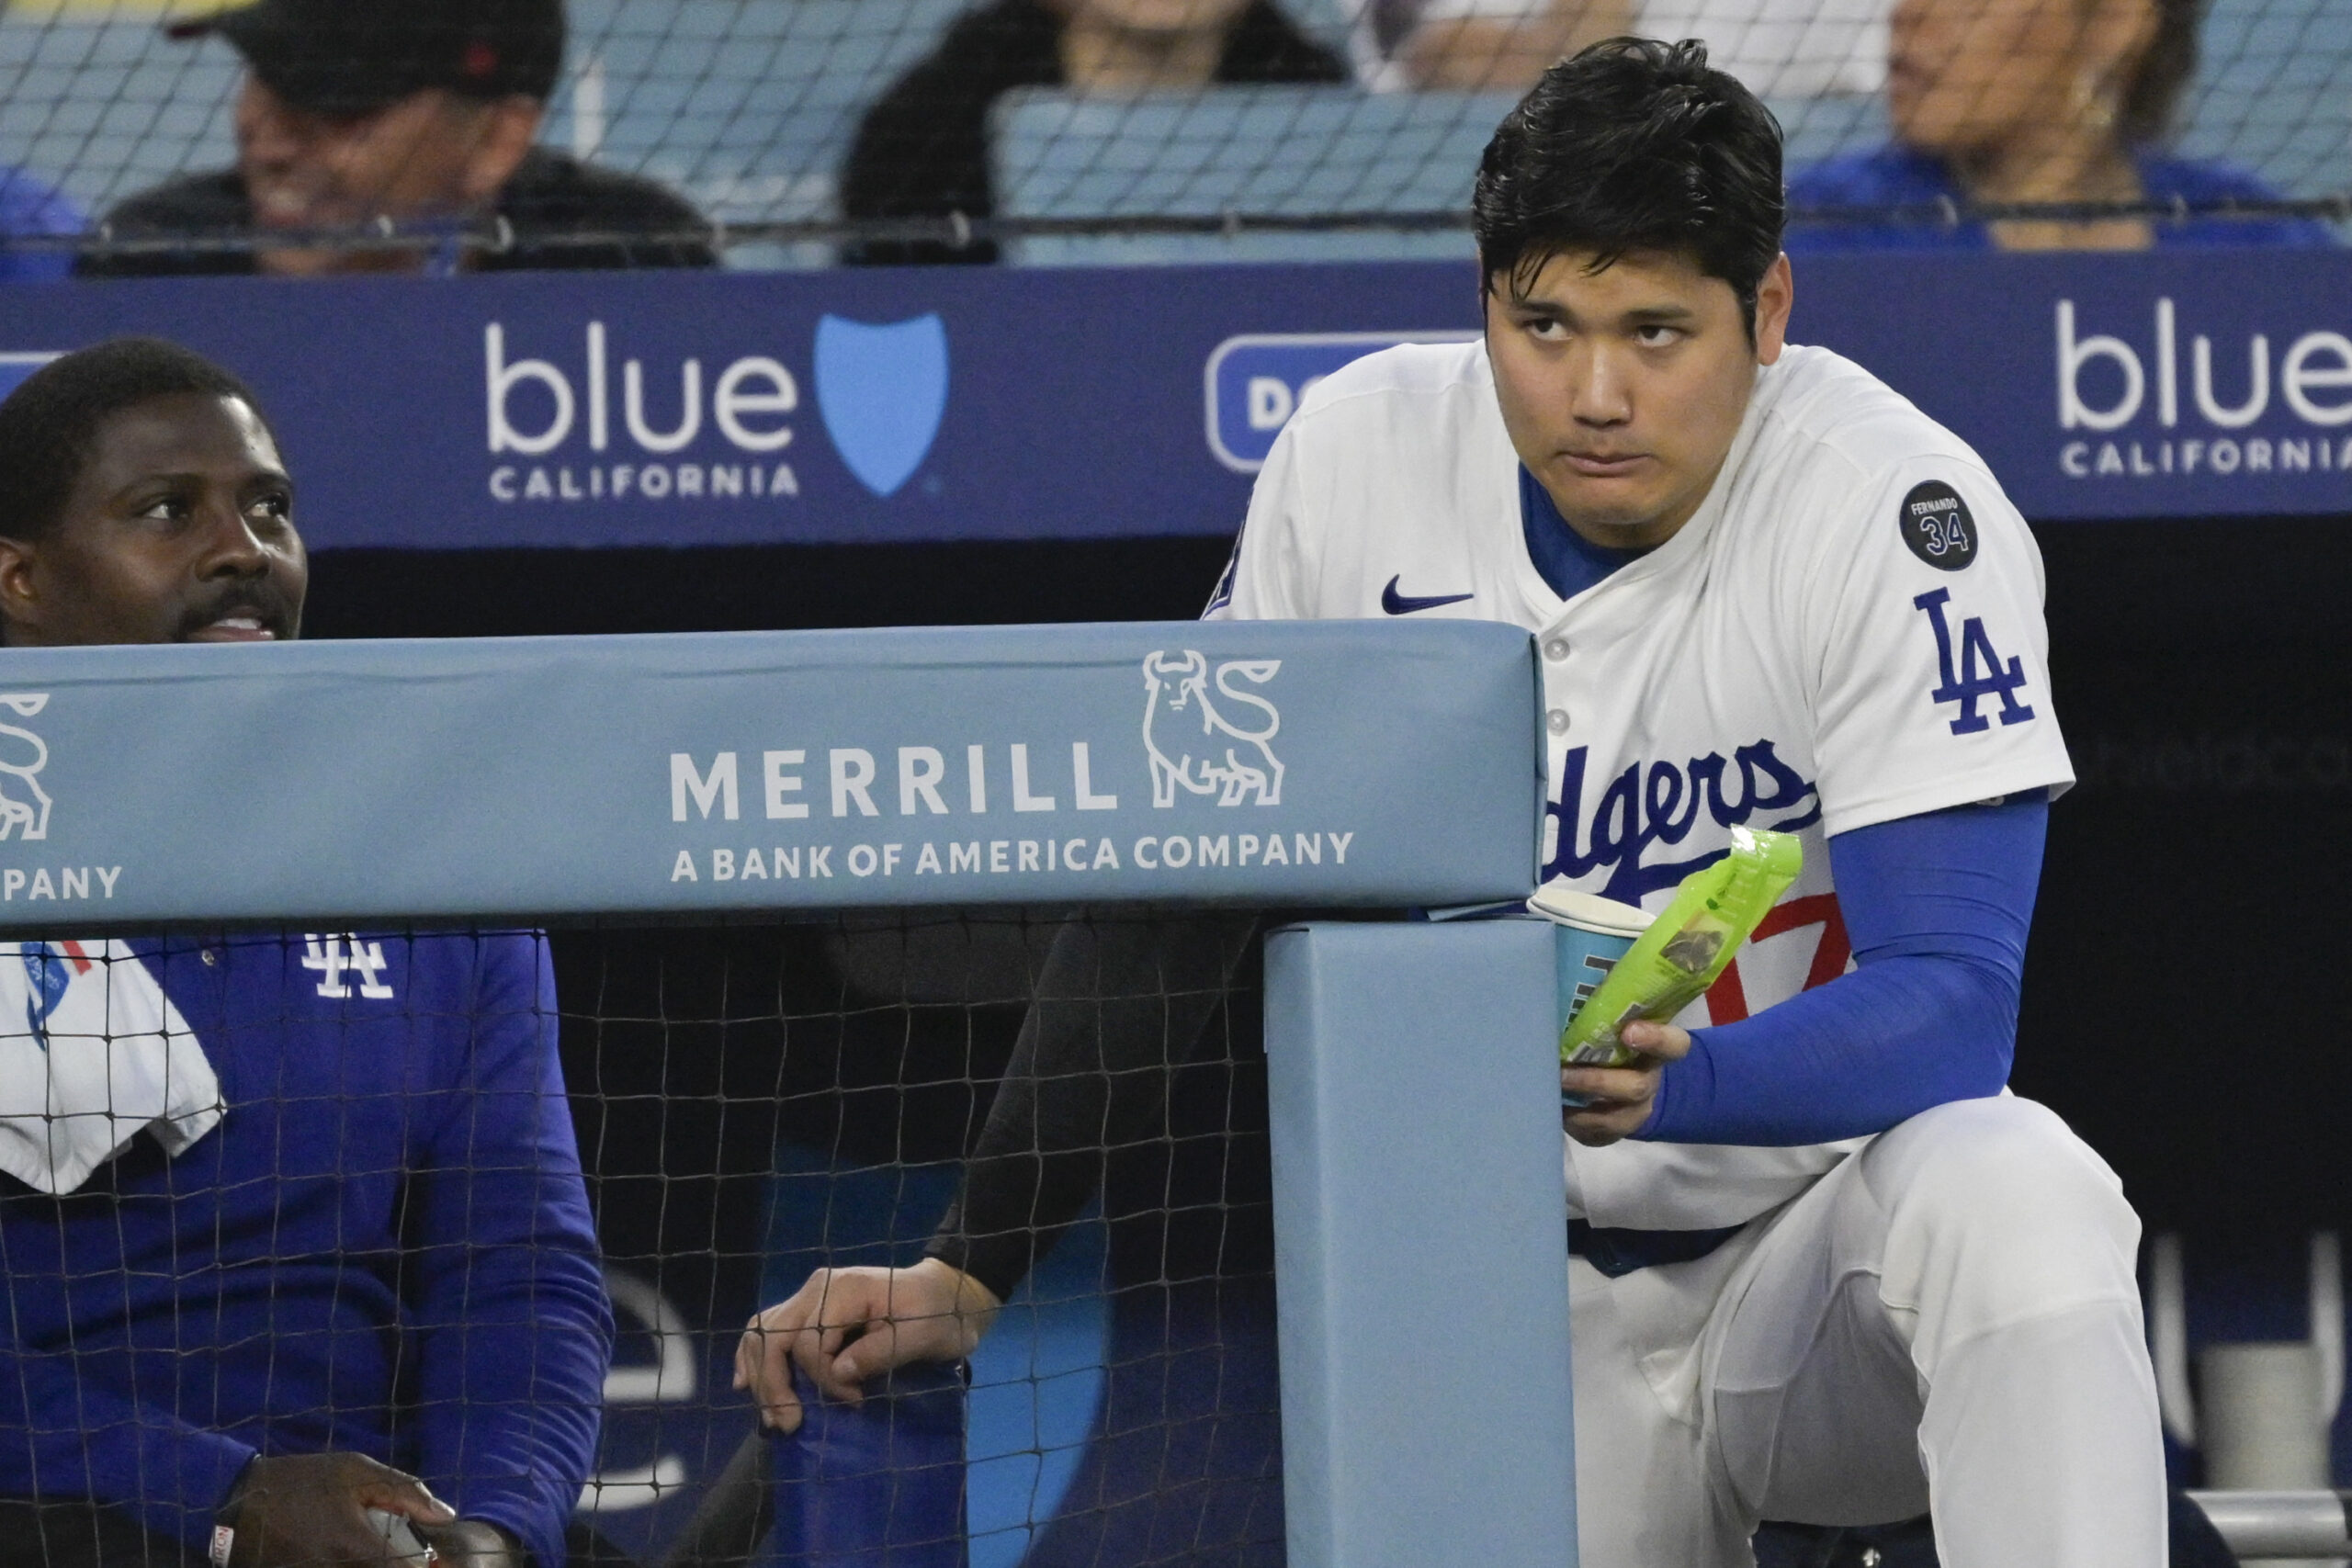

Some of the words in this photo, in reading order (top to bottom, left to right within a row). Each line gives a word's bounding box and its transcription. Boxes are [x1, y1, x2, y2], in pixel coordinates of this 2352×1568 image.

[485, 321, 798, 455] blue
[2055, 298, 2352, 431] blue
[1247, 375, 1326, 431] D
[489, 464, 799, 501] CALIFORNIA
[1911, 497, 1958, 515] FERNANDO
[1920, 512, 1969, 556] 34
[1913, 586, 2036, 736] LA
[670, 740, 1119, 823] MERRILL
[4, 866, 122, 901] PANY
[672, 850, 698, 882] A
[714, 846, 832, 881] BANK
[848, 843, 903, 877] OF
[916, 838, 1120, 875] AMERICA
[1134, 832, 1354, 869] COMPANY
